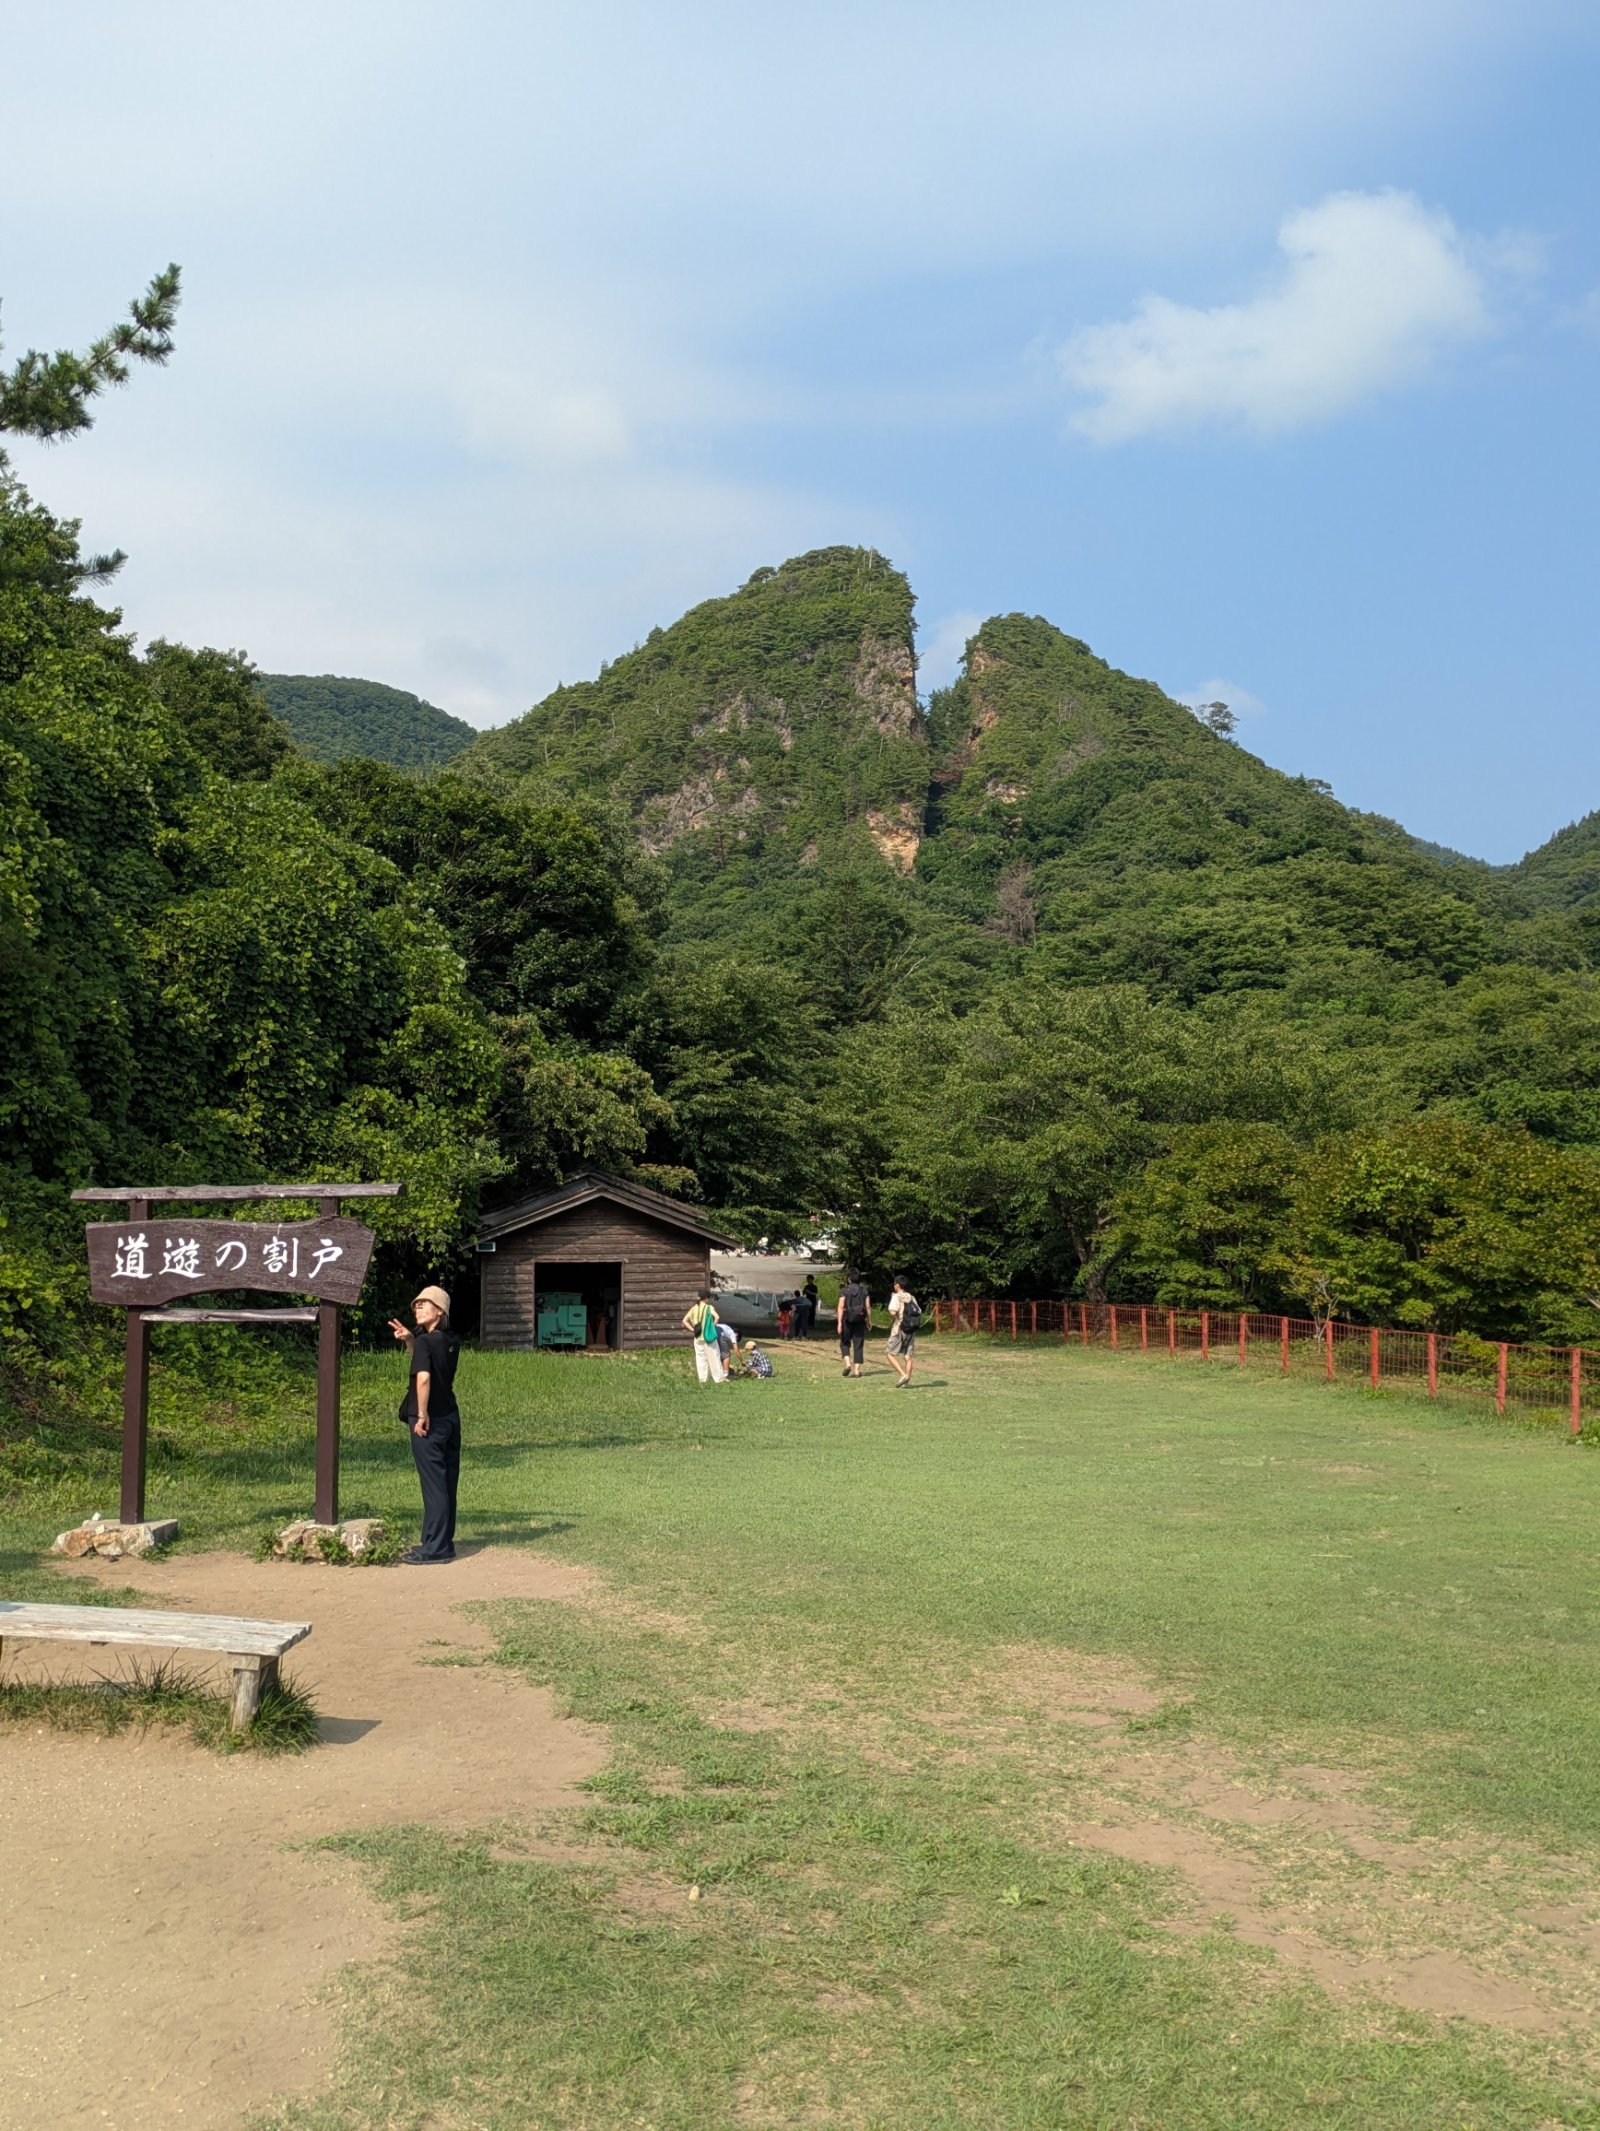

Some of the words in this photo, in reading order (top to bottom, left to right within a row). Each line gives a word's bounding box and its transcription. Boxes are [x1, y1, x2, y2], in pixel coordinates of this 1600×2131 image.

[110, 1233, 344, 1279] 道遊の割戸
